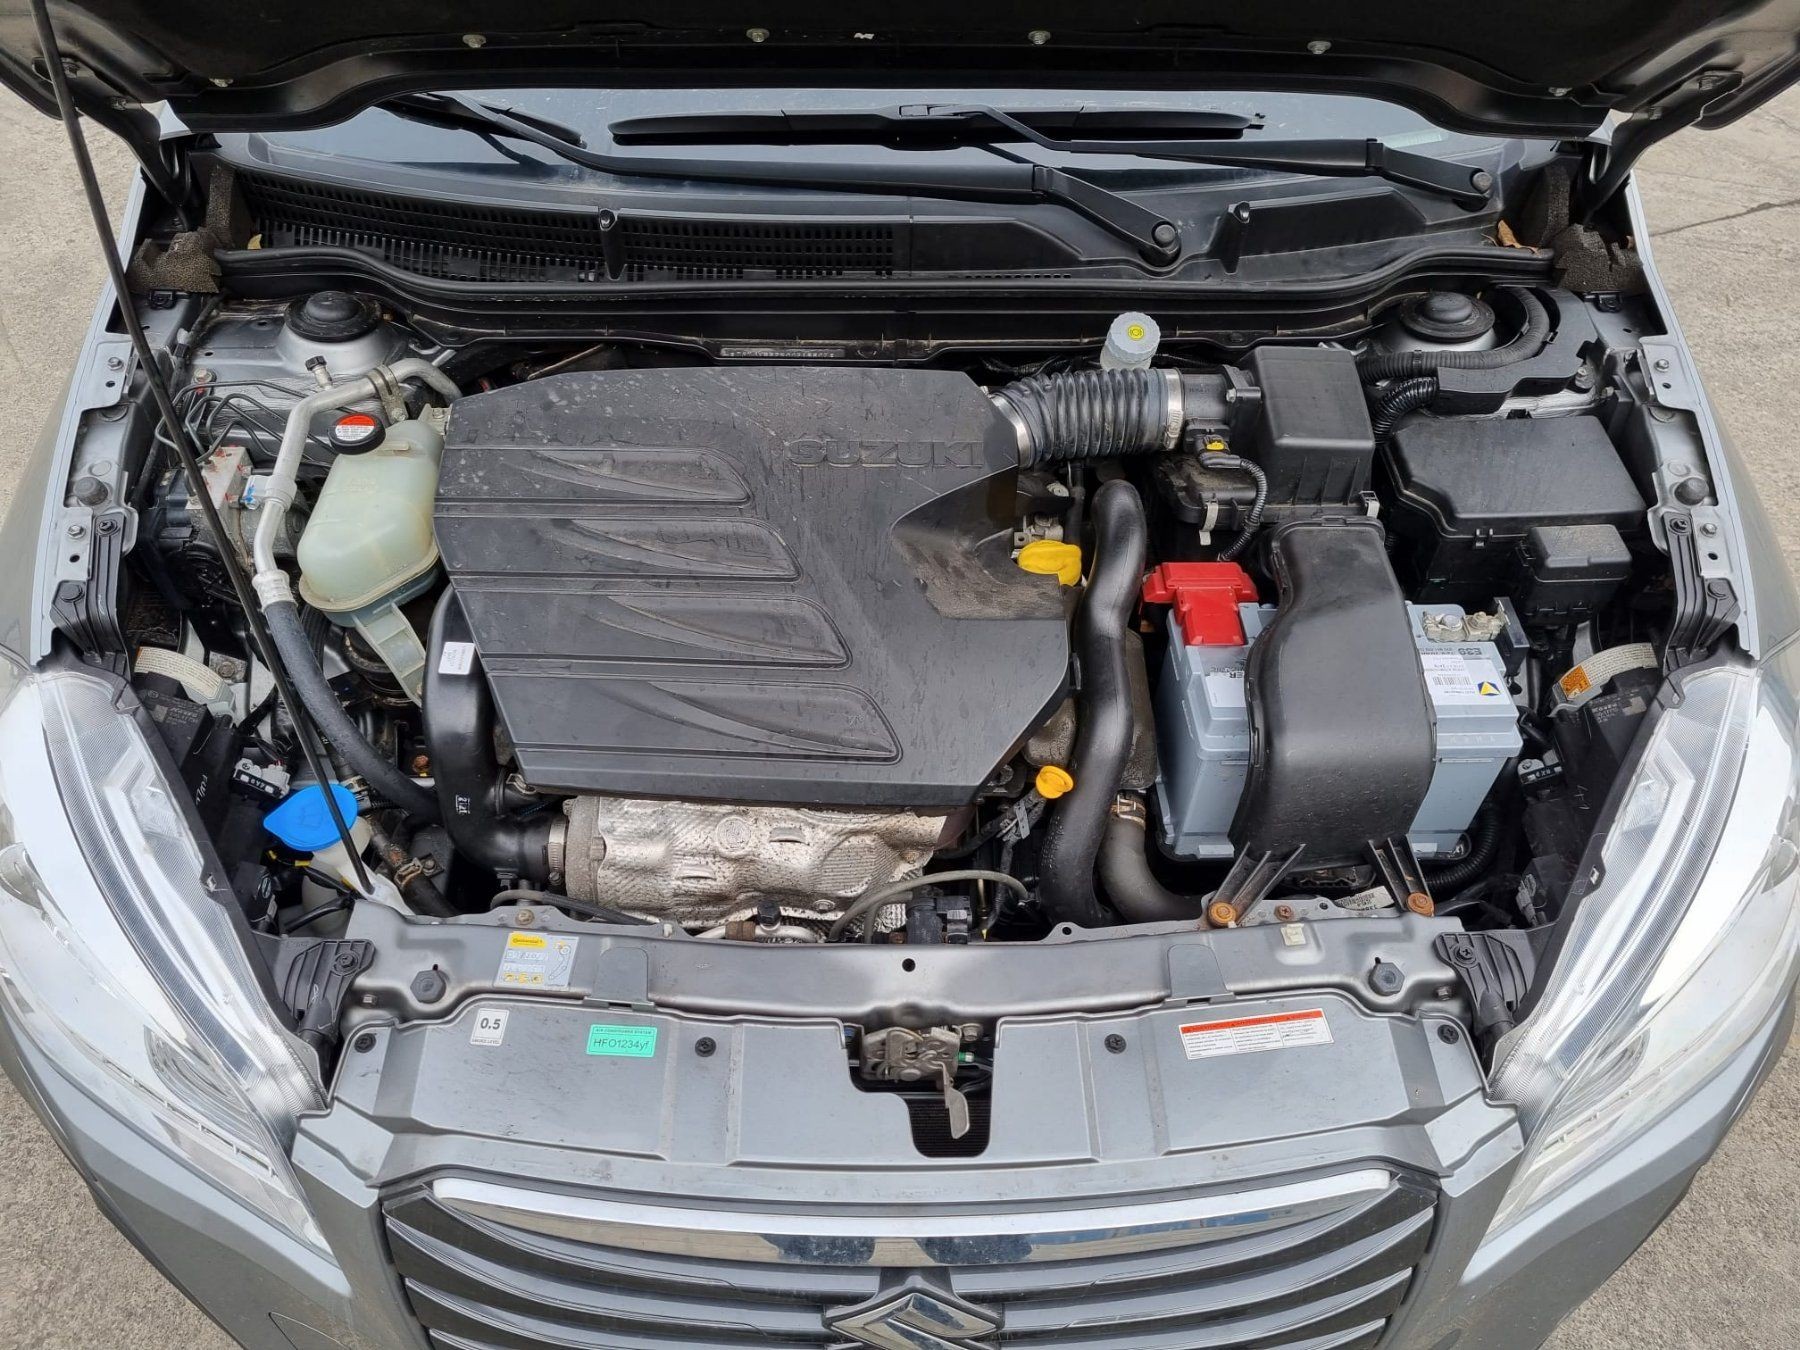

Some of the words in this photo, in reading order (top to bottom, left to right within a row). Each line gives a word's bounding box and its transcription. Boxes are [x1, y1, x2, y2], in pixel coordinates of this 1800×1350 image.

[783, 438, 984, 469] SUZUKI
[1457, 647, 1483, 656] E39
[480, 1017, 501, 1030] 0.5
[593, 1038, 650, 1052] HFO1234yf
